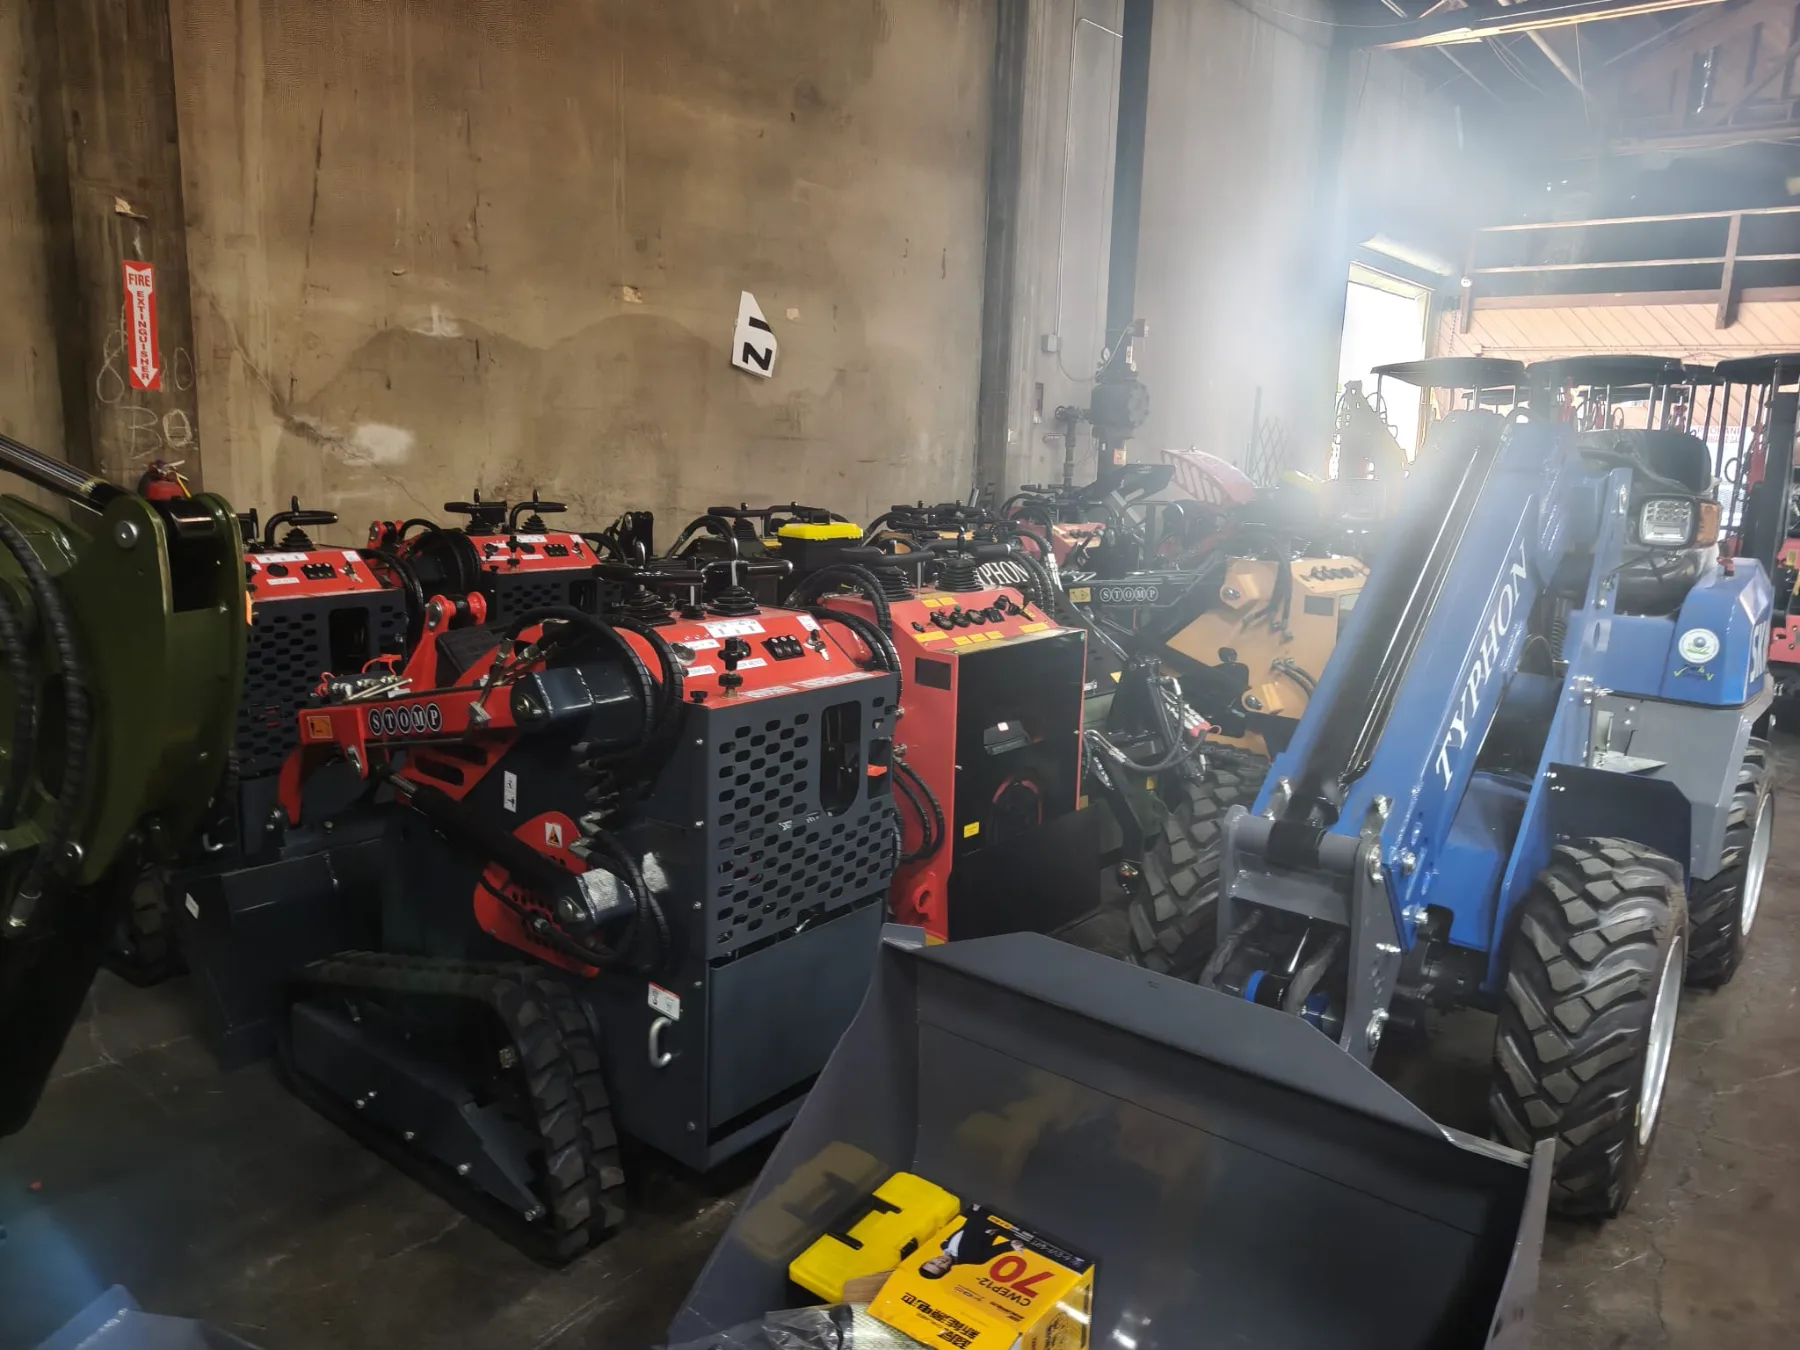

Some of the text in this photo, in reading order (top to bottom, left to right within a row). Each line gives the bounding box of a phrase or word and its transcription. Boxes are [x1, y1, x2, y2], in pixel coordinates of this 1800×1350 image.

[128, 273, 151, 288] FIRE
[136, 290, 150, 380] EXTINGUISHER
[1100, 586, 1159, 603] STOMP
[1435, 538, 1528, 791] TYPHON
[369, 703, 442, 736] STOMP
[988, 1255, 1056, 1298] 70
